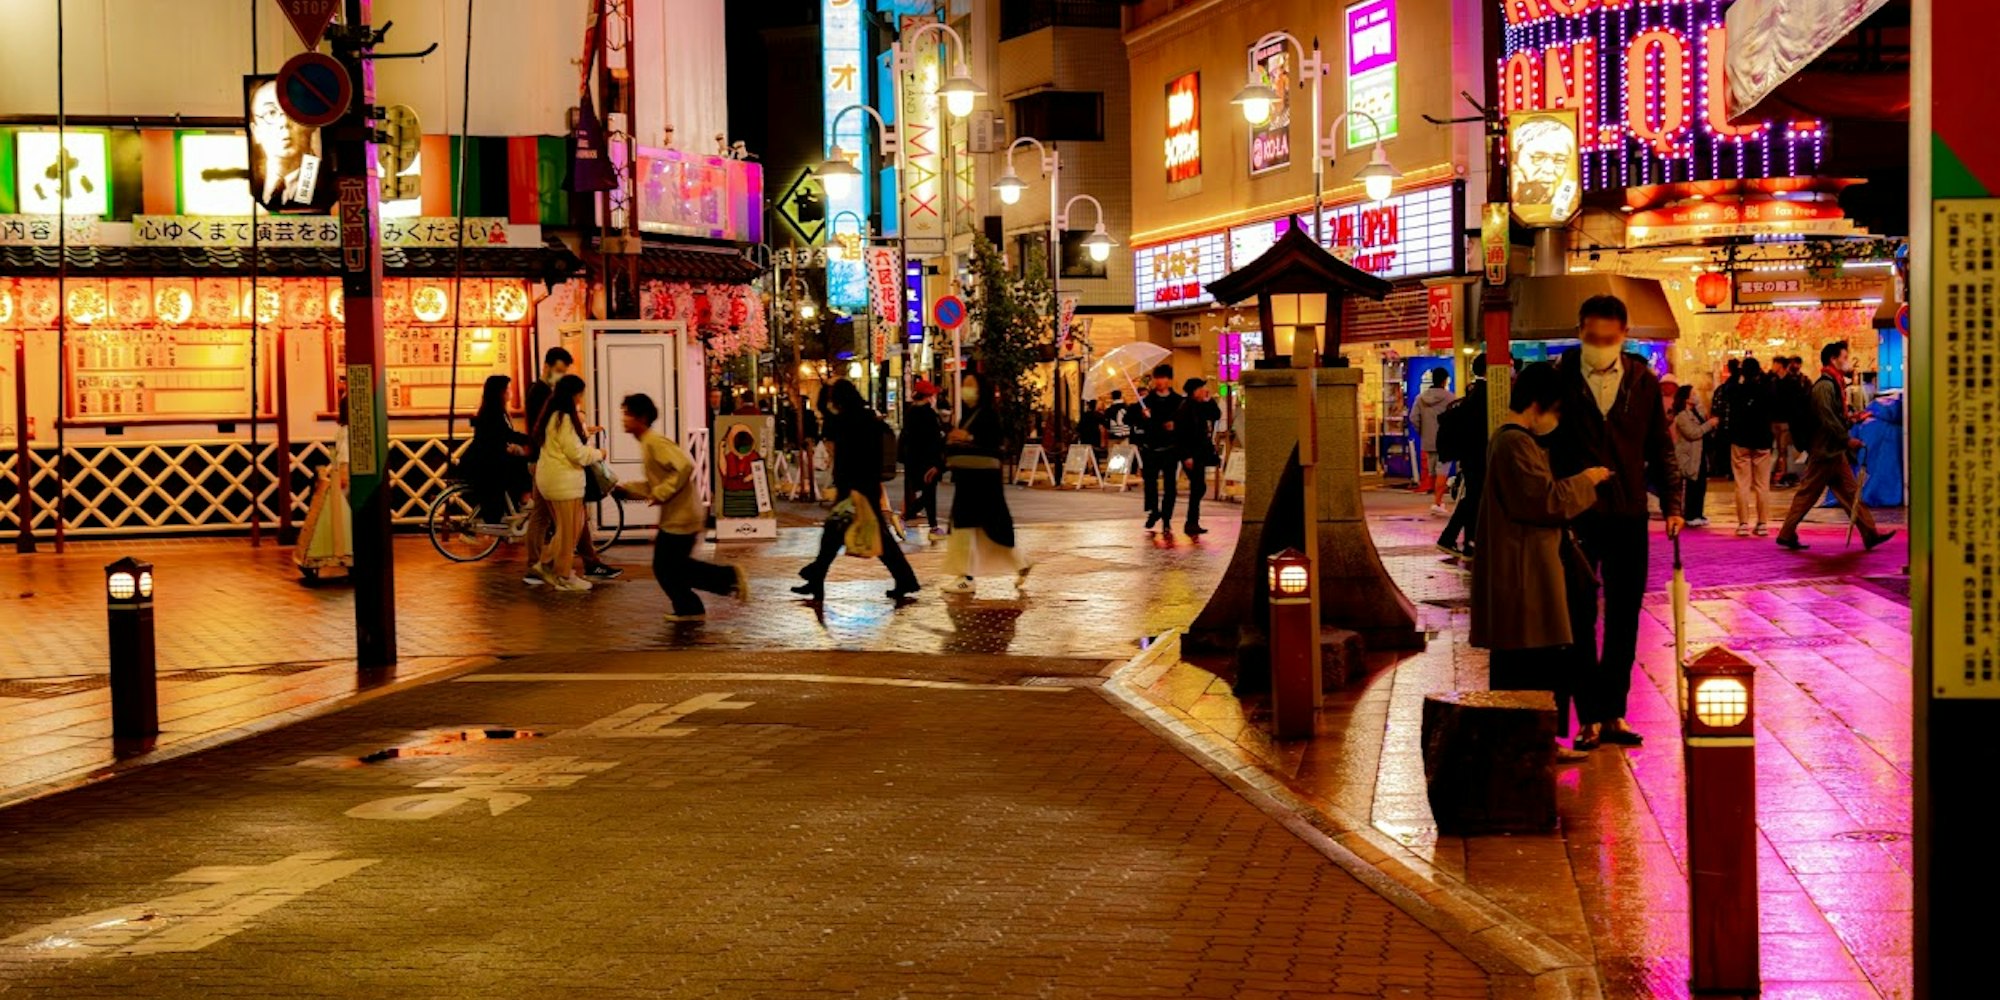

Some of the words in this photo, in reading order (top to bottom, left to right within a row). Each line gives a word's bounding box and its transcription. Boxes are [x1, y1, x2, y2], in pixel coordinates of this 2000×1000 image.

[292, 1, 329, 15] STOP
[906, 123, 939, 217] MAX
[4, 220, 51, 240] 内容
[139, 221, 487, 244] 心ゆくまで演芸をおみください
[340, 178, 367, 272] 六区通り
[1362, 205, 1398, 248] OPEN
